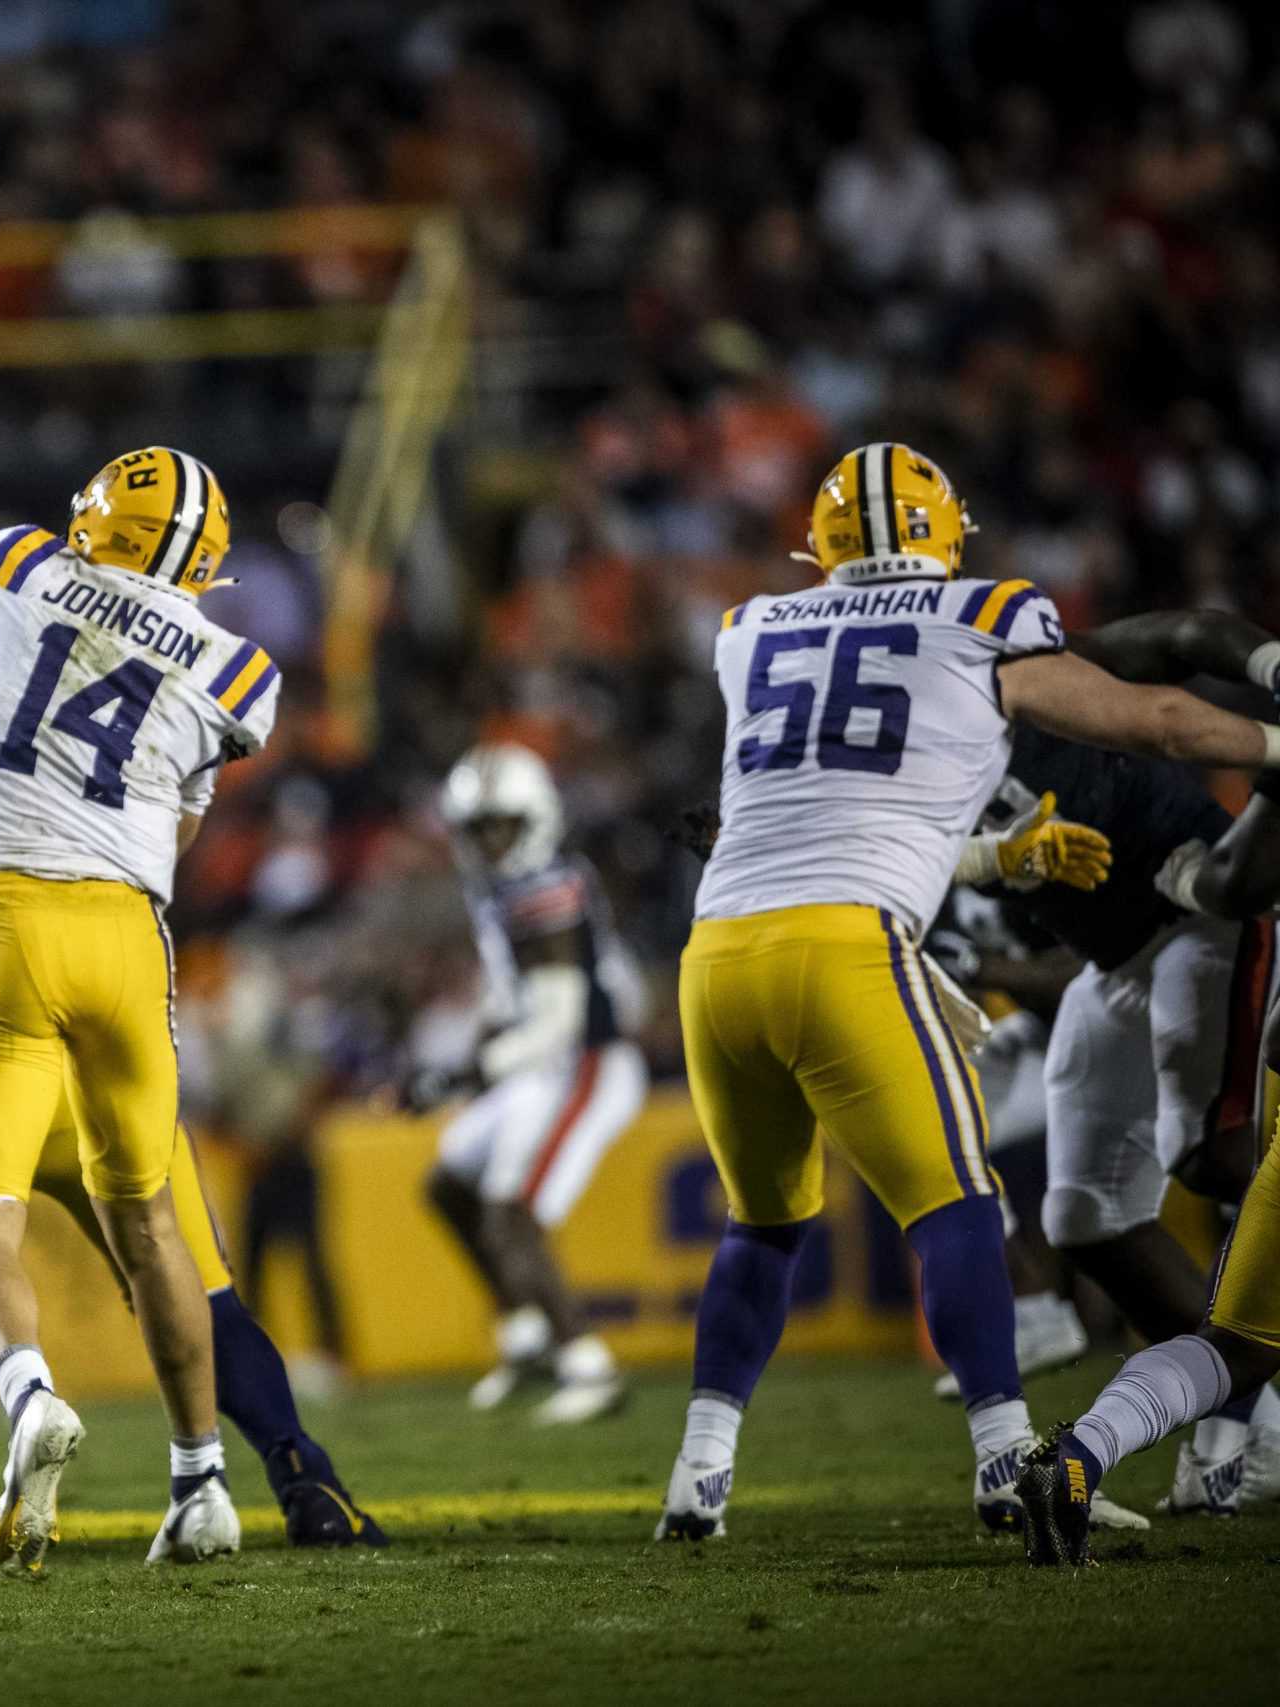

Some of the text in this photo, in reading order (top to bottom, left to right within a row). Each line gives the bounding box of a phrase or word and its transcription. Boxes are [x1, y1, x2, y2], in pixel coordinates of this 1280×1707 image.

[41, 577, 206, 670] JOHNSON
[761, 585, 944, 623] SHANAHAN
[737, 623, 919, 777] 56
[979, 1446, 1020, 1494] NIK
[1064, 1457, 1088, 1504] NIKE
